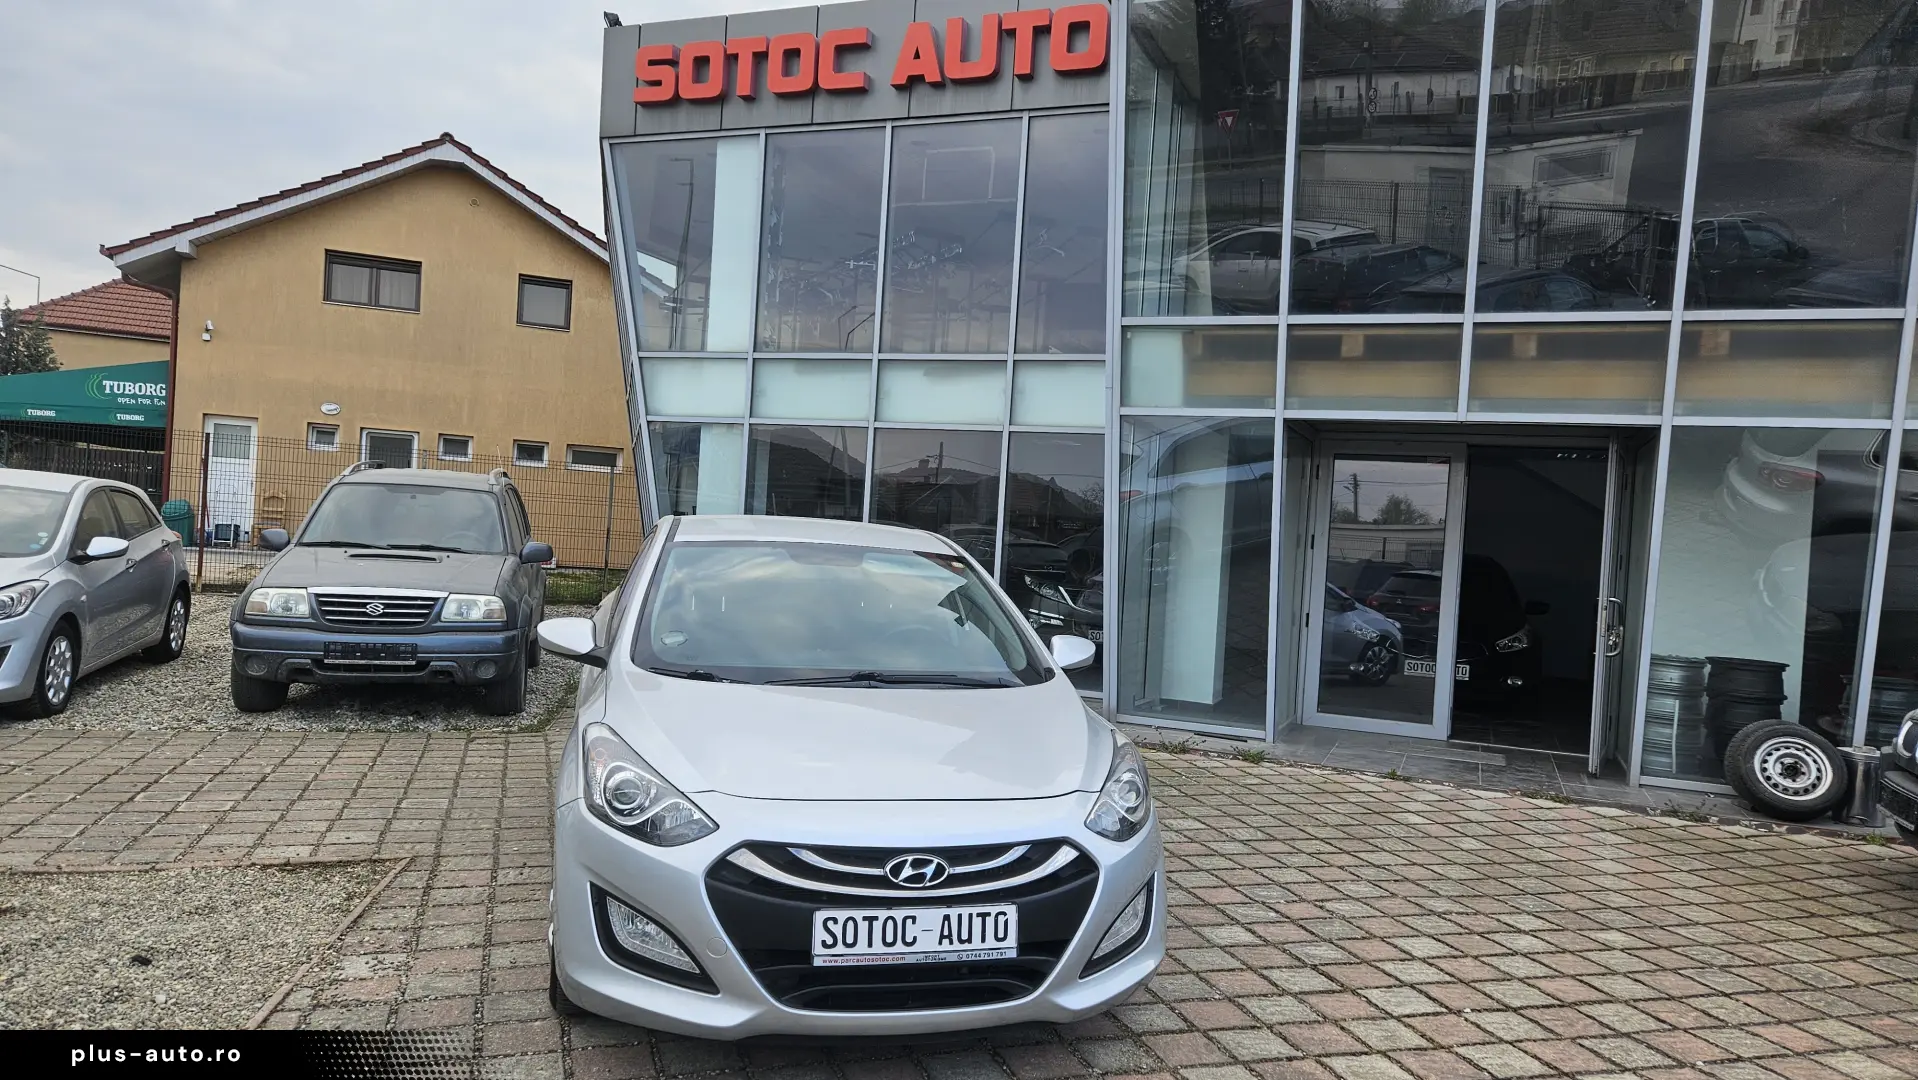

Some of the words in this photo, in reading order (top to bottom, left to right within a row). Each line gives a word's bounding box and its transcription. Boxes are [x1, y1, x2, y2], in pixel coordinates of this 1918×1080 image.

[634, 27, 873, 107] SOTOC
[890, 3, 1110, 89] AUTO
[102, 380, 166, 397] TUBORG
[153, 398, 166, 406] FUN
[26, 408, 56, 417] TUBORG
[115, 413, 145, 421] TUBORG
[822, 955, 906, 965] www.parcautosotoc.com
